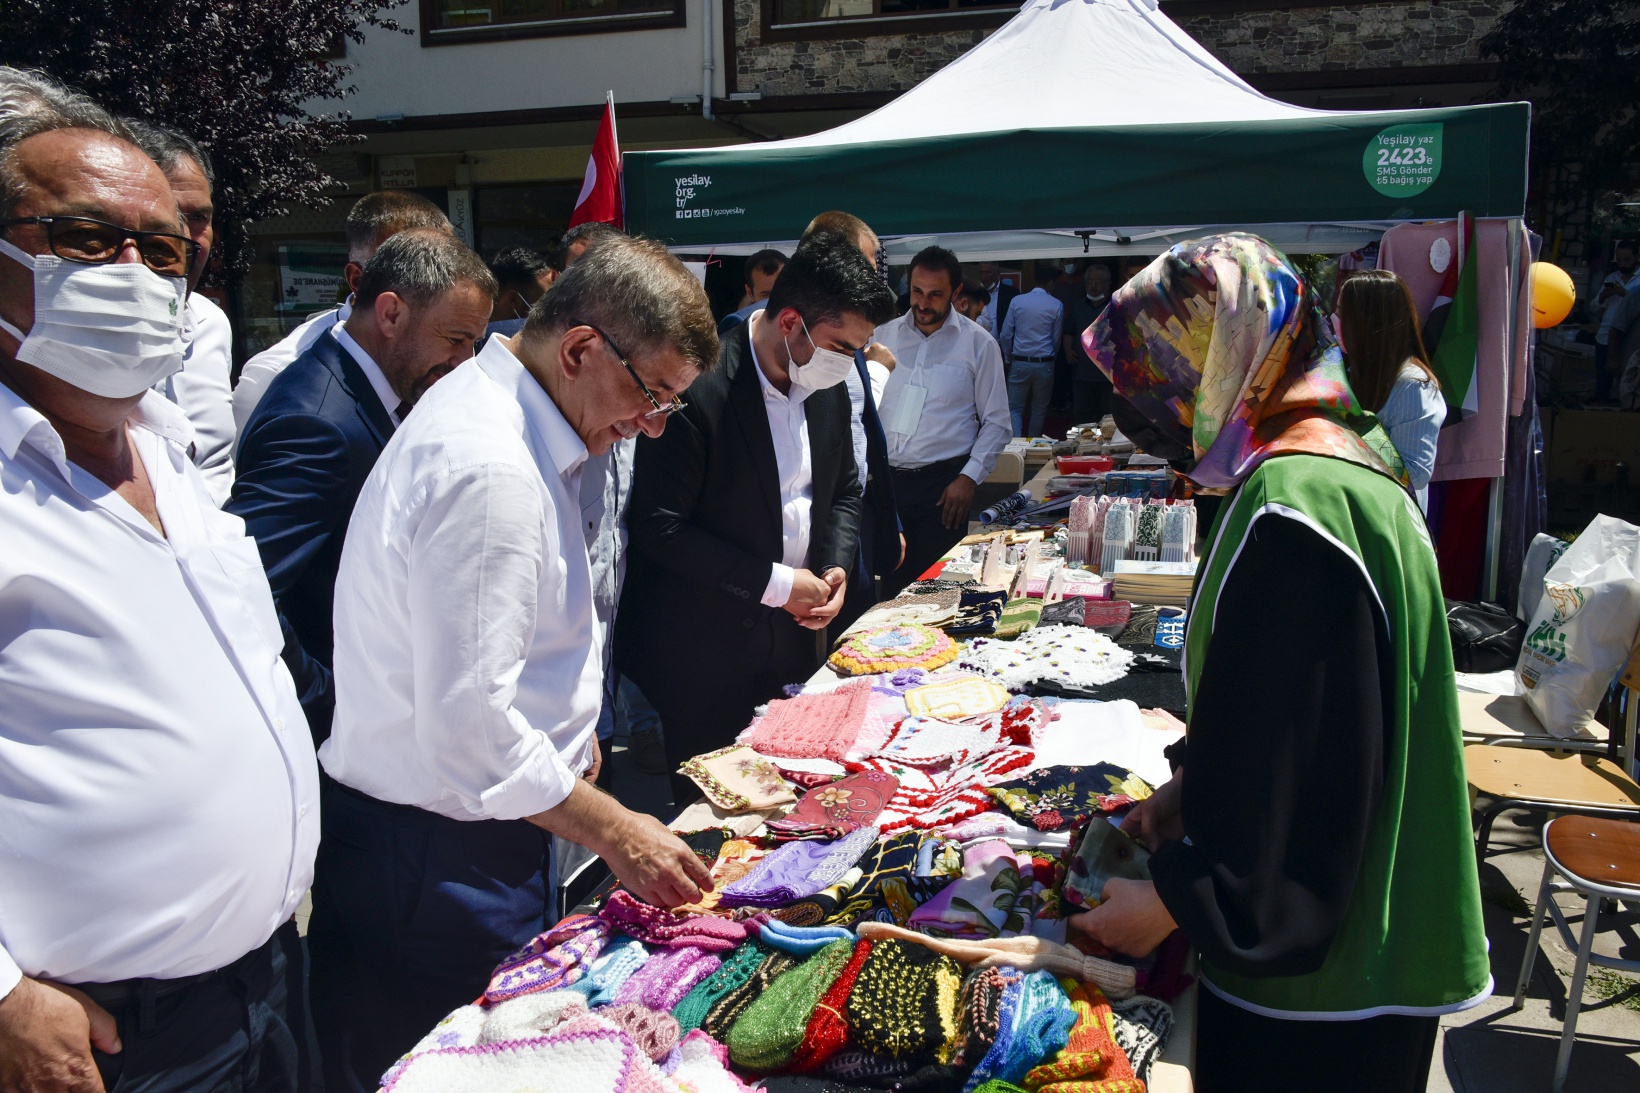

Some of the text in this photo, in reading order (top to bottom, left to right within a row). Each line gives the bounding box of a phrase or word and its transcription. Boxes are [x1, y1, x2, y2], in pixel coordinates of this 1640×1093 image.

[1377, 134, 1434, 147] Yeşilay yaz
[1377, 166, 1432, 175] SMS Gönder
[1390, 176, 1414, 186] bağış
[1416, 176, 1433, 185] yap
